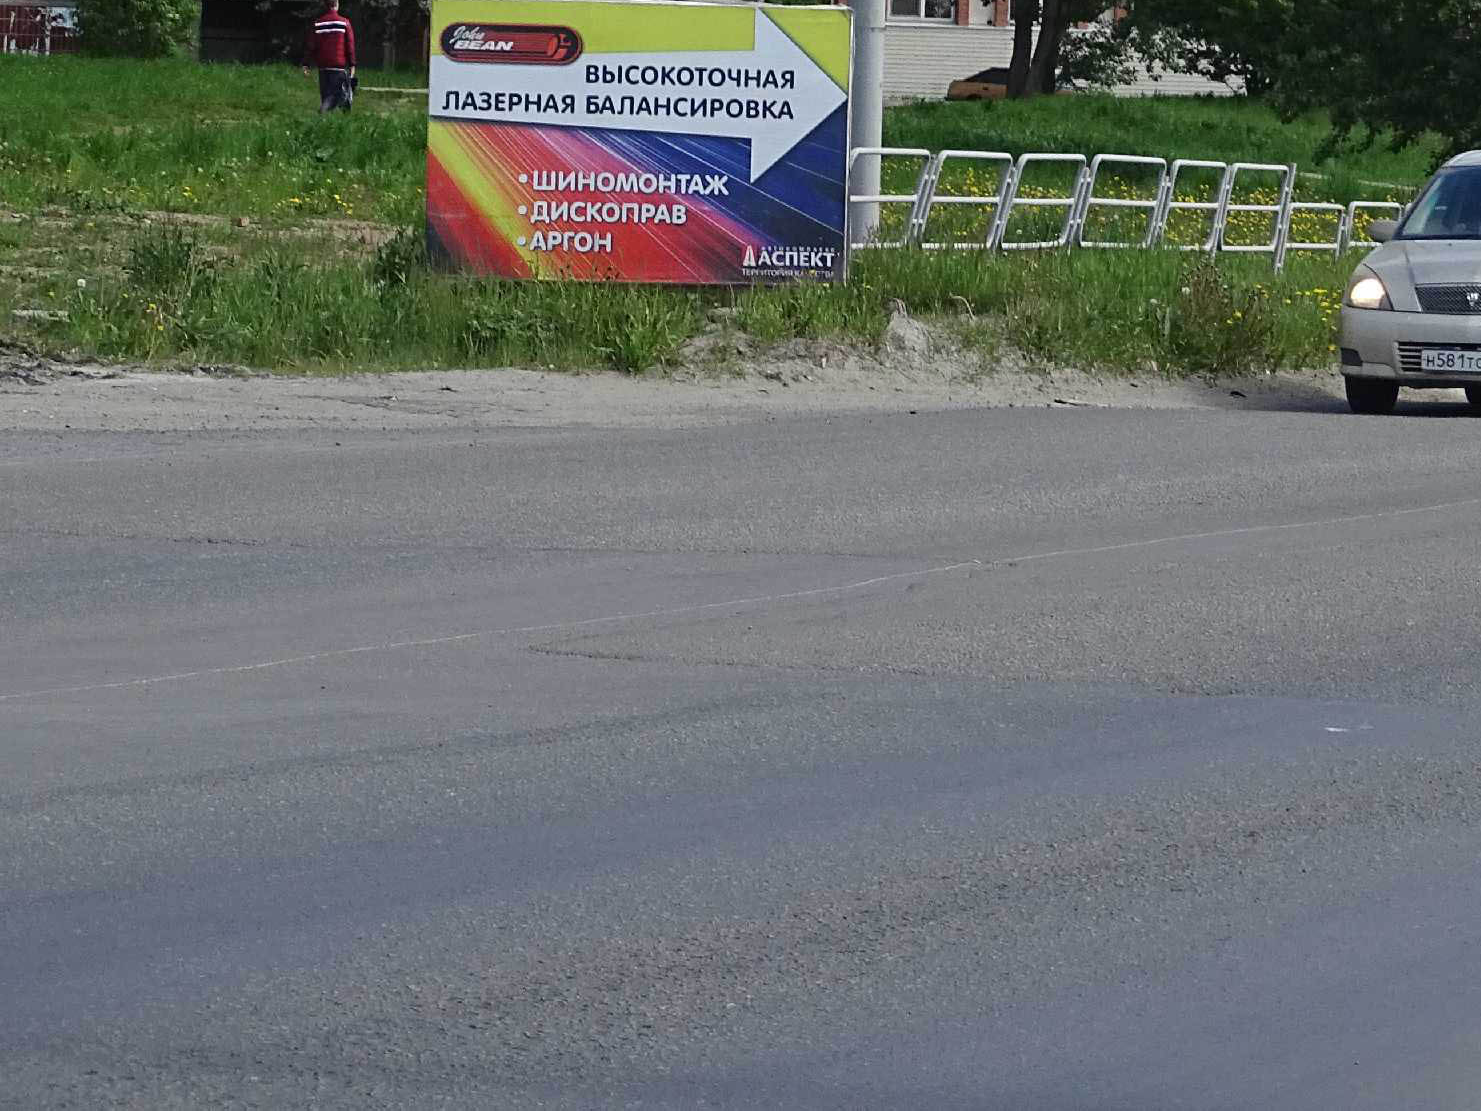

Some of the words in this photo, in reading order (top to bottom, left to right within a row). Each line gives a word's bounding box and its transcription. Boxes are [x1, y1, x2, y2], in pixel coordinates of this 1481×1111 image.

[449, 25, 486, 44] John
[453, 40, 514, 51] BEAN
[585, 64, 796, 90] ВЫСОКОТОЧНАЯ
[442, 90, 576, 114] ЛАЗЕРНАЯ
[585, 95, 795, 120] БАЛАНСИРОВКА
[532, 171, 730, 196] ШИНОМОНТАЖ
[530, 201, 688, 225] ДИСКОПРАВ
[529, 231, 613, 253] АРГОН
[758, 251, 834, 267] АСПЕКТ
